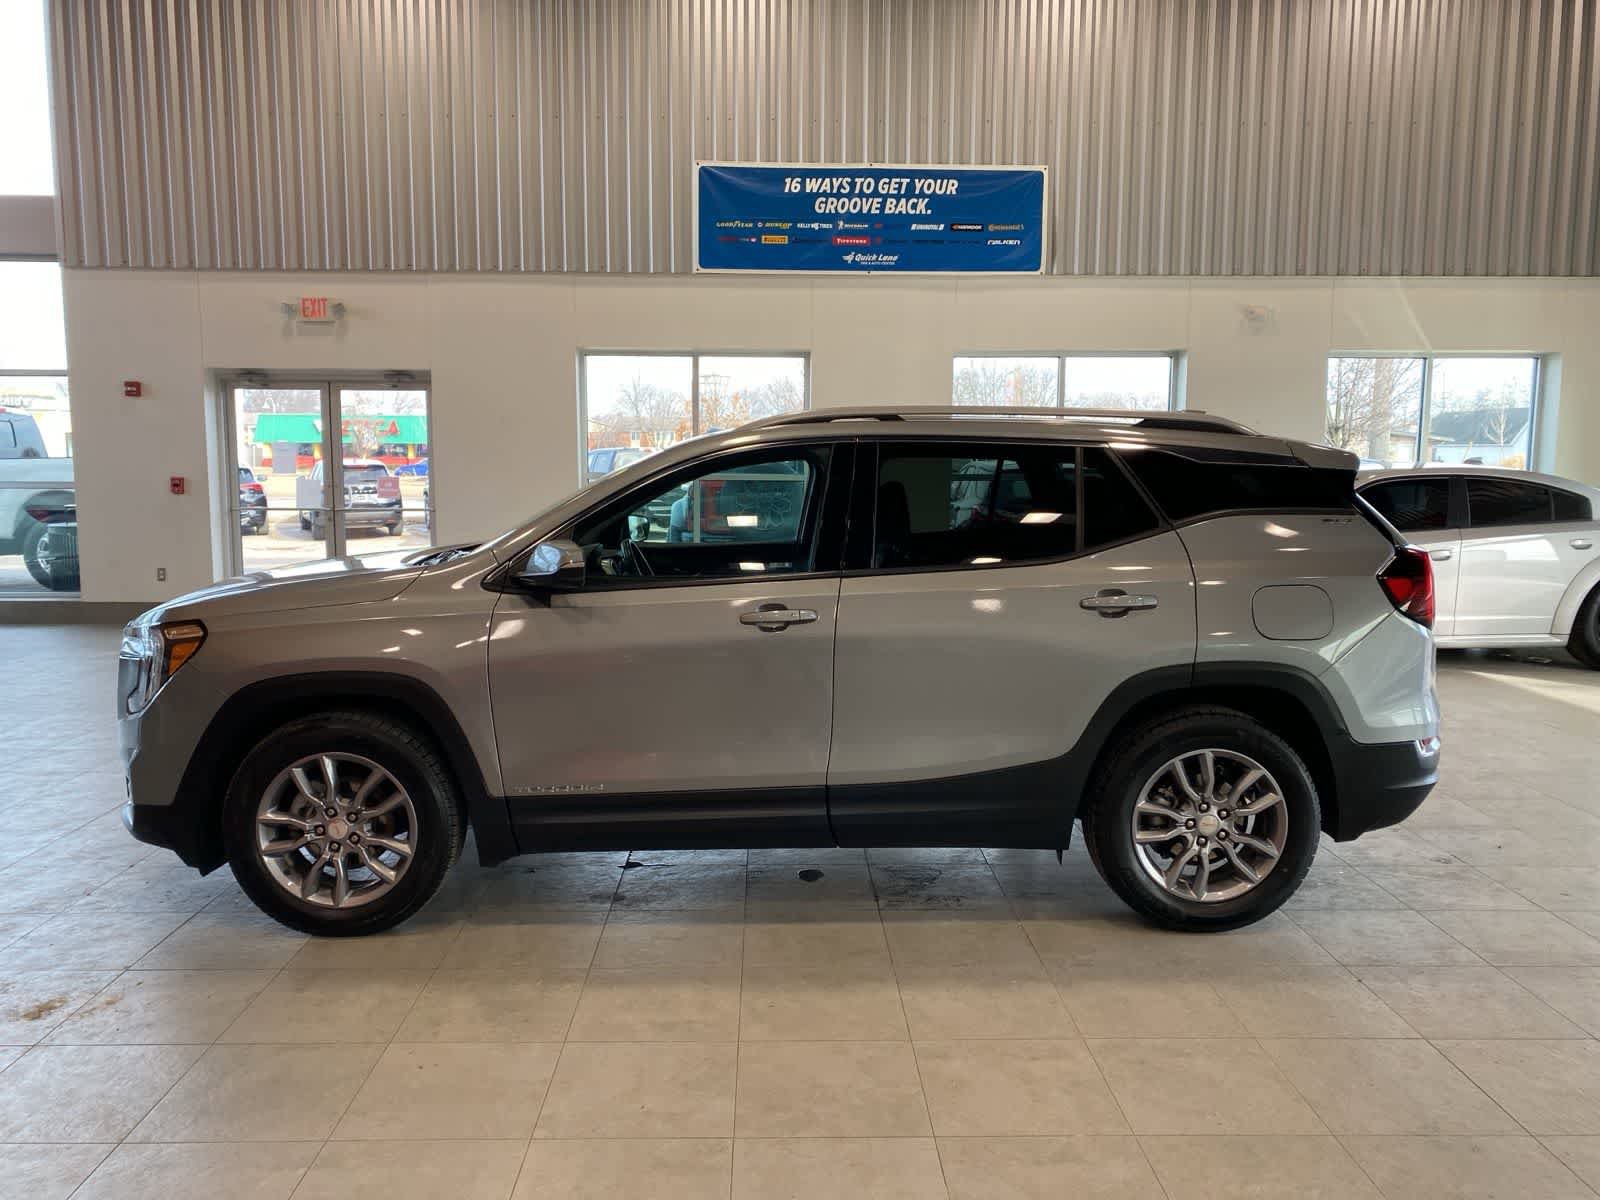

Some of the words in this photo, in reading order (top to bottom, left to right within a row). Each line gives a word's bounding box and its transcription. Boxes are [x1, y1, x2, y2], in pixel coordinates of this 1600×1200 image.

[784, 177, 802, 193] 16
[805, 177, 851, 194] WAYS
[854, 178, 876, 194] TO
[878, 178, 910, 195] GET
[914, 179, 959, 195] YOUR
[814, 197, 882, 215] GROOVE
[884, 198, 932, 215] BACK.
[855, 253, 877, 262] Quick
[878, 253, 898, 262] Lane
[301, 297, 328, 318] EXIT
